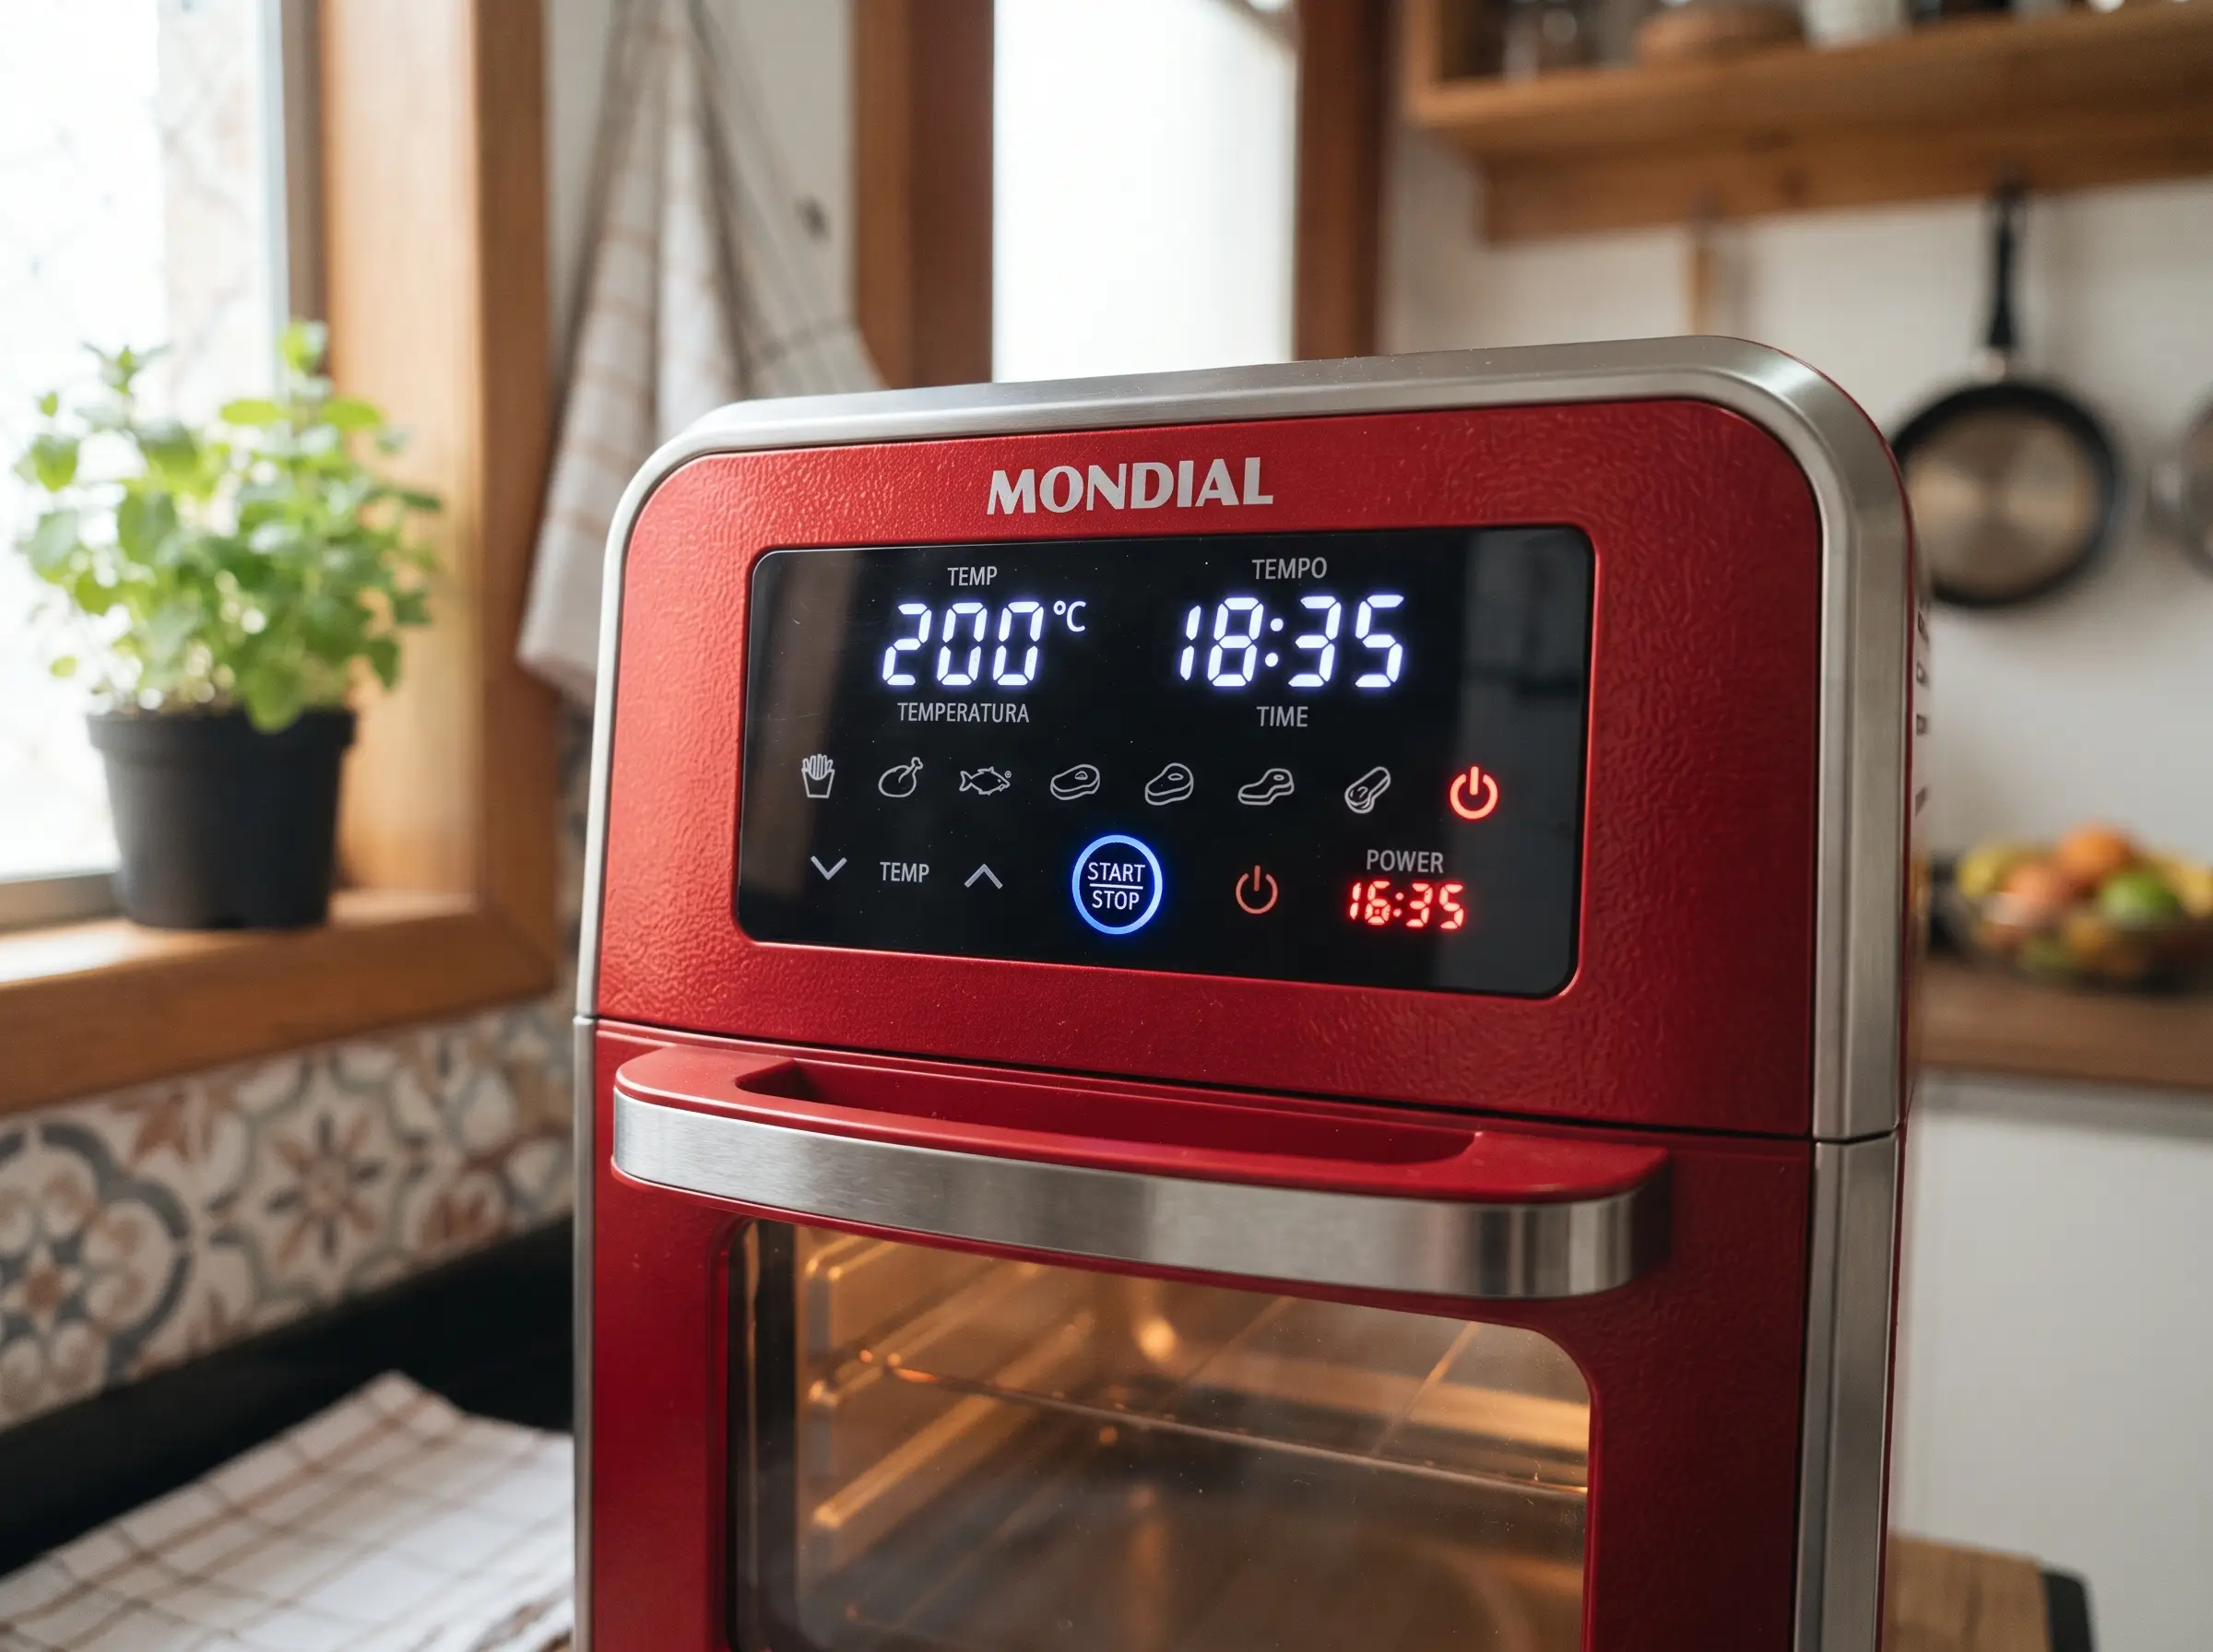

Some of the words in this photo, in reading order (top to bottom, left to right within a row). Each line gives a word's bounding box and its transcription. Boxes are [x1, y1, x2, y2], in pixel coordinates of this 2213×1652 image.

[987, 456, 1273, 515] MONDIAL
[947, 566, 998, 586] TEMP
[1251, 557, 1328, 580] TEMPO
[882, 601, 1044, 686] 200
[1179, 595, 1404, 688] 18:35
[897, 702, 1030, 724] TEMPERATURA
[1257, 706, 1308, 727] TIME
[880, 861, 929, 883] TEMP
[1087, 862, 1146, 883] START
[1366, 849, 1444, 874] POWER
[1092, 890, 1140, 911] STOP
[1348, 880, 1465, 931] 16:35
